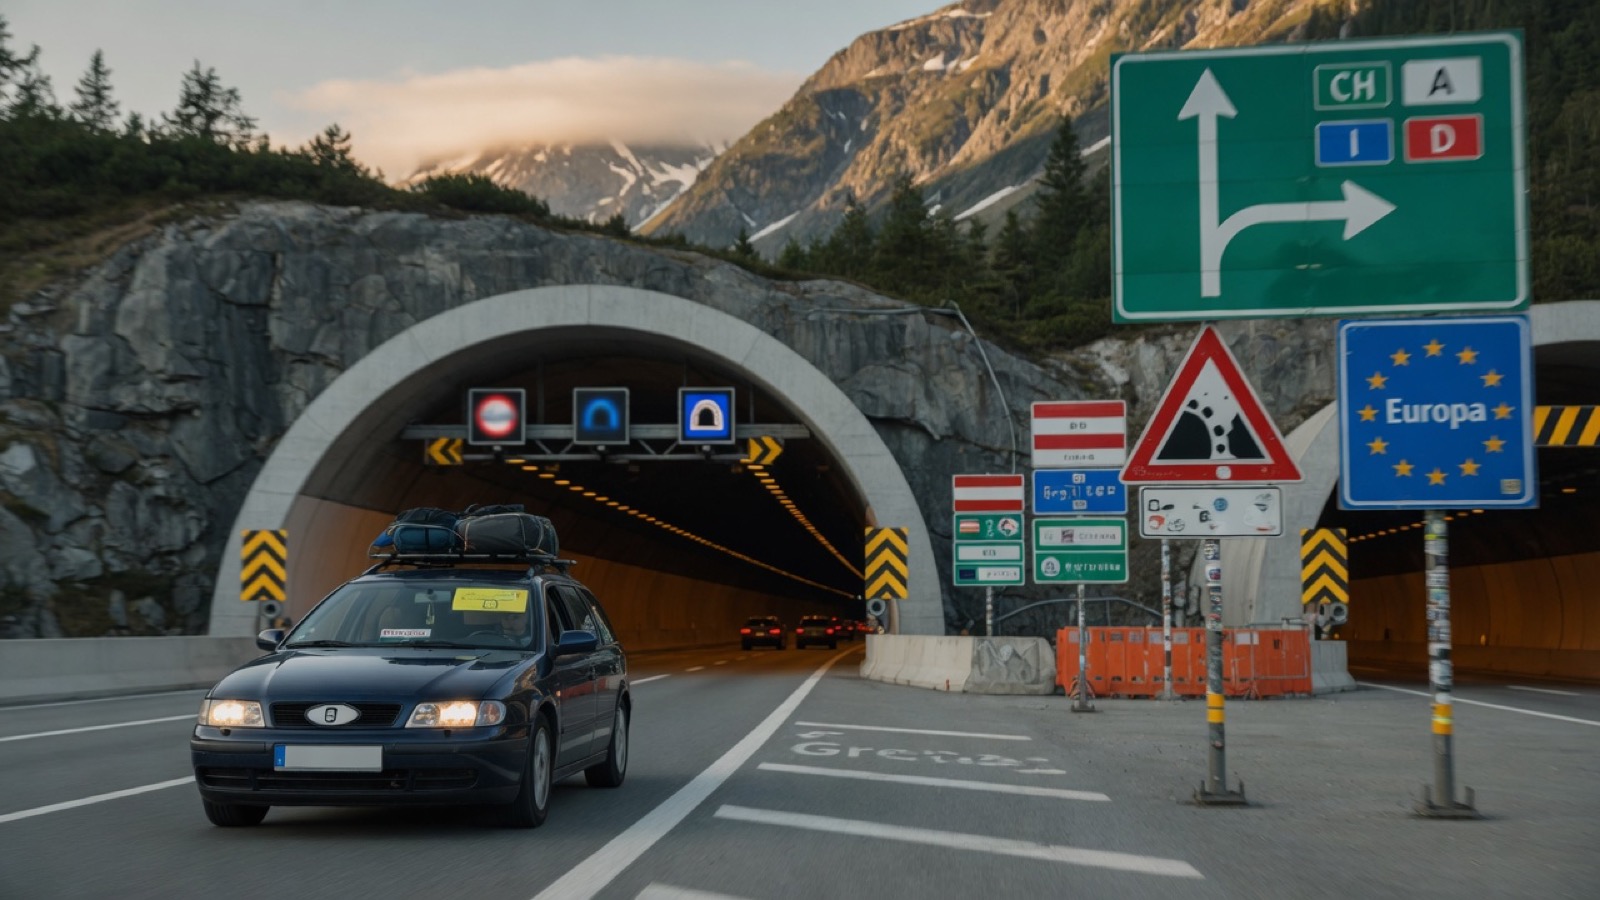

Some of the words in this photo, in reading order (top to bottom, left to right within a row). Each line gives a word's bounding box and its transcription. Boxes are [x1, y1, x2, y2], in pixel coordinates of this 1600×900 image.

[1330, 70, 1375, 102] CH
[1428, 66, 1455, 97] A
[1350, 128, 1359, 158] I
[1430, 124, 1456, 154] D
[1385, 398, 1487, 430] Europa
